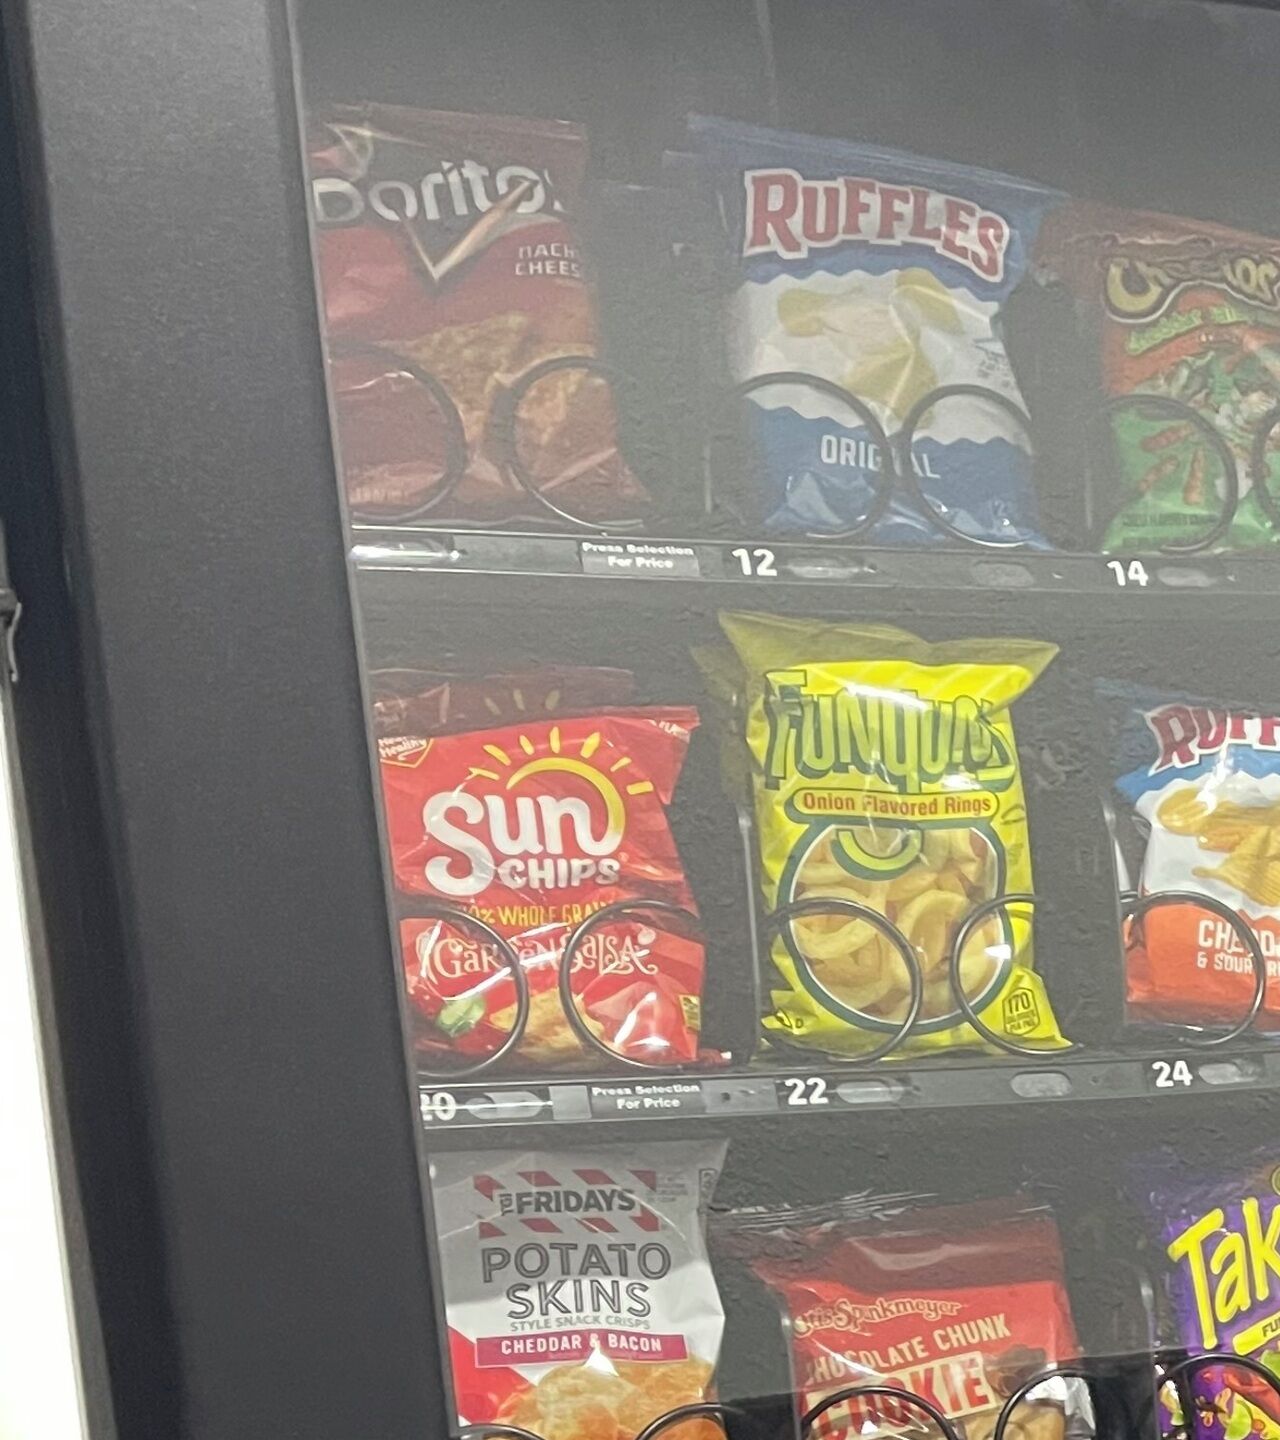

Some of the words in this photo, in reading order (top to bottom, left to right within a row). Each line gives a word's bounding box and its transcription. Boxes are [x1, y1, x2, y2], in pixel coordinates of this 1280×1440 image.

[745, 168, 1009, 281] RUFFLES
[731, 548, 777, 578] 12
[1107, 560, 1149, 587] 14
[803, 792, 855, 811] Onion
[862, 794, 938, 815] Flavored
[944, 796, 992, 818] Rings
[423, 791, 622, 897] Sun
[499, 857, 621, 890] CHIPS
[499, 905, 557, 927] WHOLE
[1152, 1061, 1193, 1088] 24
[785, 1077, 829, 1106] 22
[515, 1188, 636, 1214] FRIDAYS
[481, 1242, 672, 1283] POTATO
[506, 1279, 651, 1320] SKINS
[510, 1317, 552, 1332] STYLE
[555, 1315, 600, 1329] SNACK
[605, 1315, 651, 1330] CRISPS
[937, 1313, 1011, 1349] CHUNK
[501, 1334, 581, 1355] CHEDDAR
[607, 1333, 662, 1352] BACON
